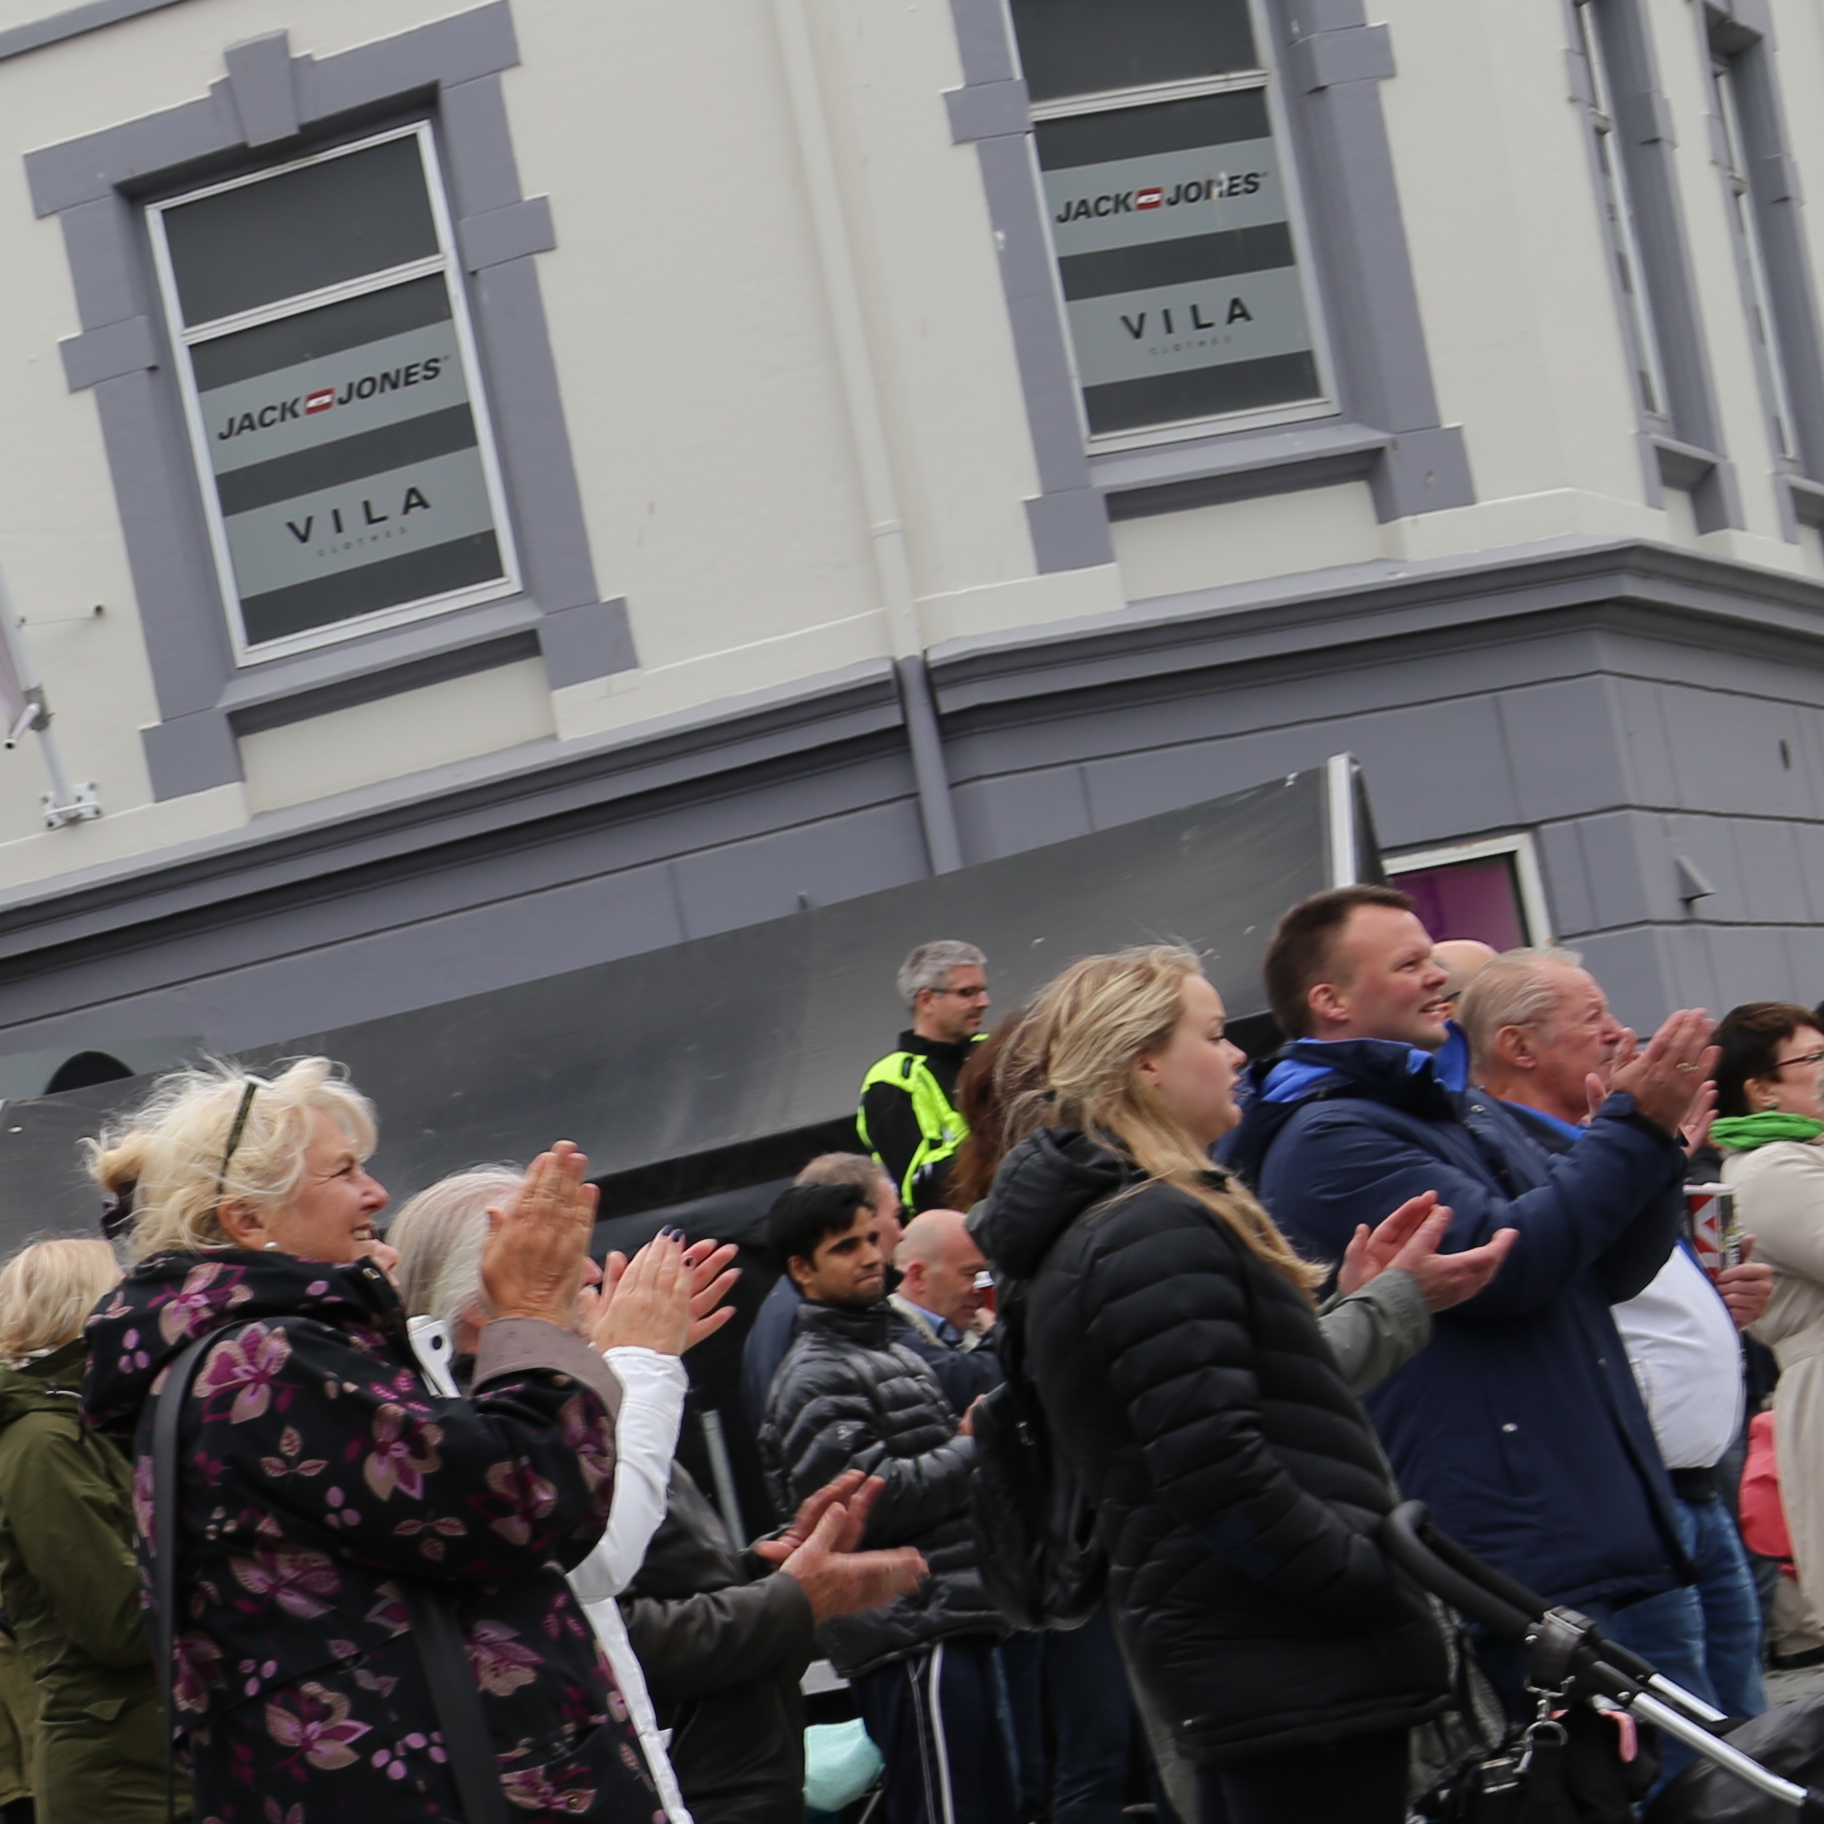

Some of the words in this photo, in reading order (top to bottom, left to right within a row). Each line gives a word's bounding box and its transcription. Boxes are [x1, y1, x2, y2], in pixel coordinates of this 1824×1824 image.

[1056, 190, 1135, 223] JACK
[1166, 172, 1262, 207] JONES
[1120, 296, 1254, 340] VILA
[218, 396, 302, 441] JACK
[336, 357, 442, 406] JONES
[286, 486, 432, 544] VILA
